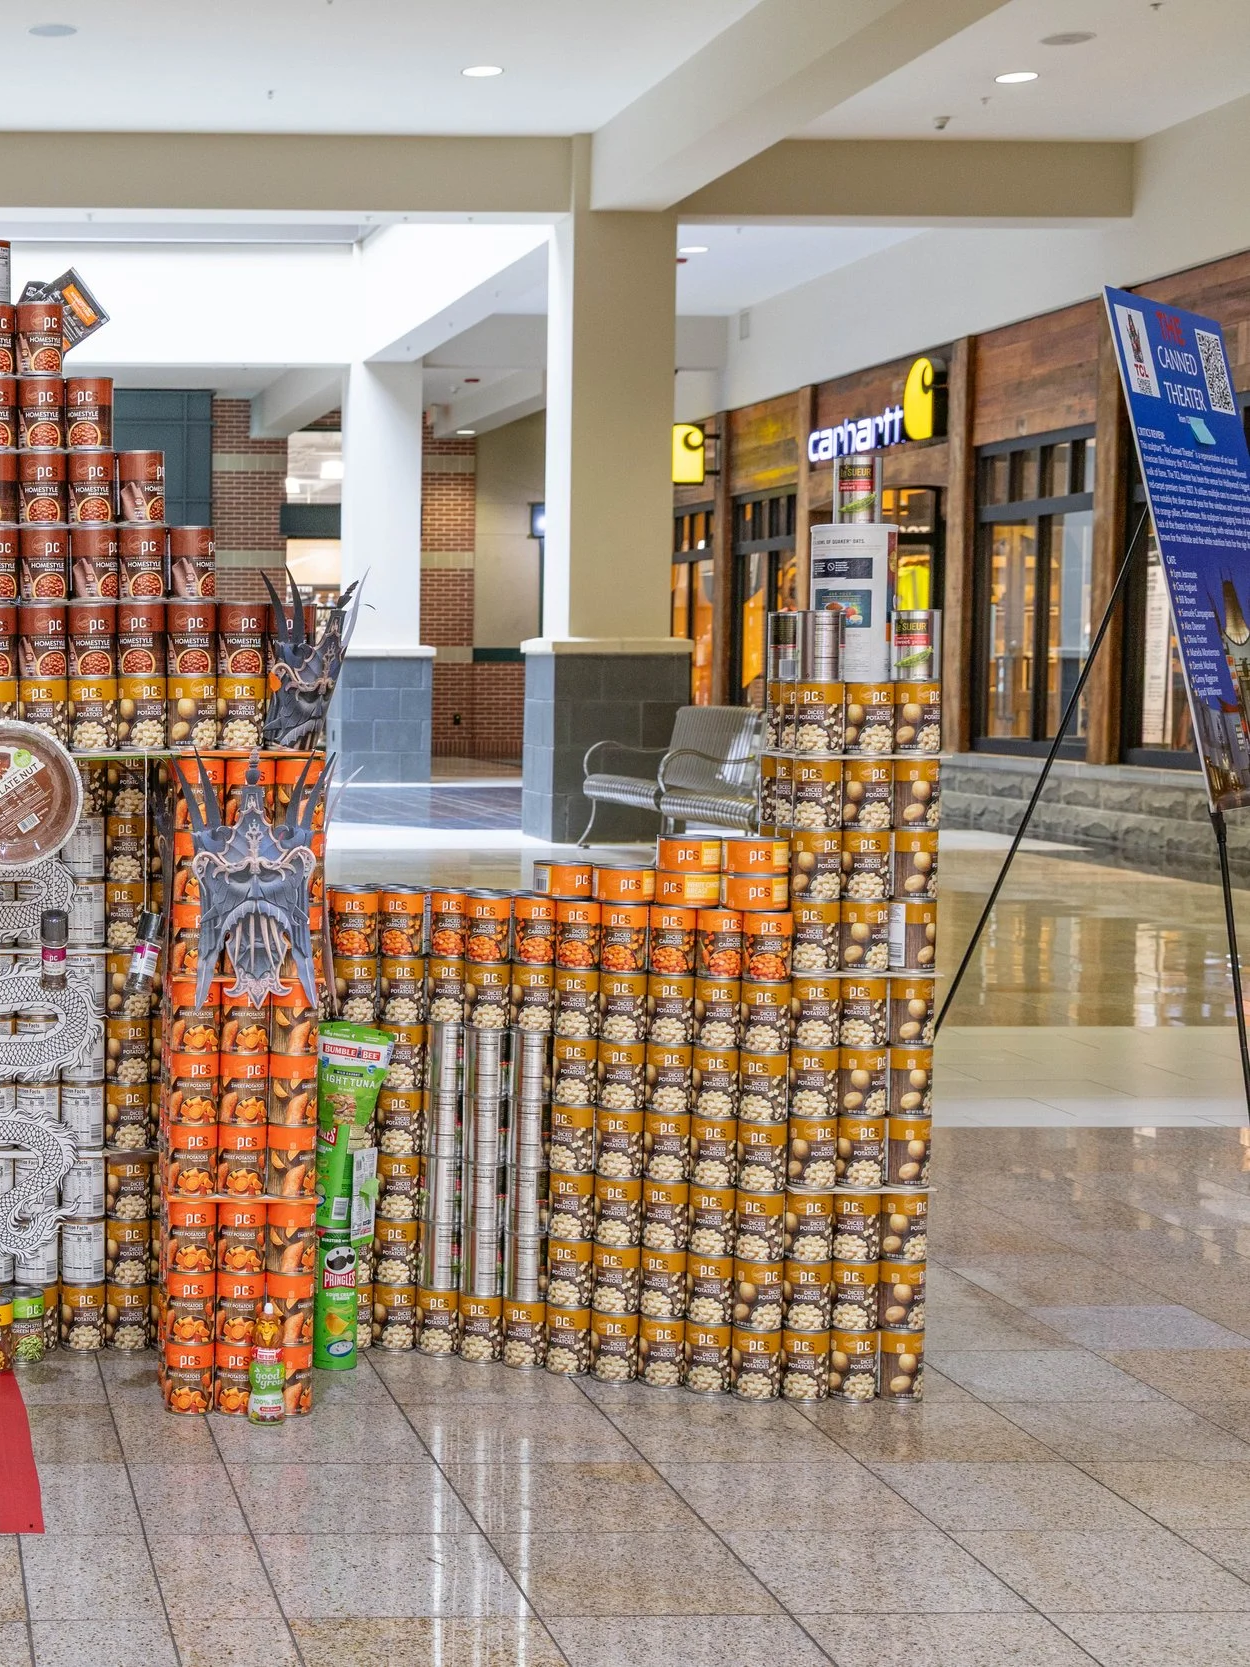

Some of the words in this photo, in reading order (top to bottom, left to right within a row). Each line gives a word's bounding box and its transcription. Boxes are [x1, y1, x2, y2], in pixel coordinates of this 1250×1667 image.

[1156, 310, 1186, 347] THE
[1157, 345, 1198, 376] CANNED
[1134, 363, 1149, 378] TCL
[1163, 381, 1208, 412] THEATER
[25, 411, 59, 419] HOMESTYLE
[807, 404, 904, 462] carhartt
[847, 467, 872, 477] SUEUR
[902, 621, 927, 632] SUEUR
[20, 762, 38, 782] NUT
[325, 1044, 357, 1056] BUMBLE
[362, 1051, 379, 1060] BEE
[322, 1073, 347, 1085] LIGHT
[350, 1077, 375, 1088] TUNA
[324, 1272, 356, 1287] PRINGLES
[255, 1369, 280, 1382] good
